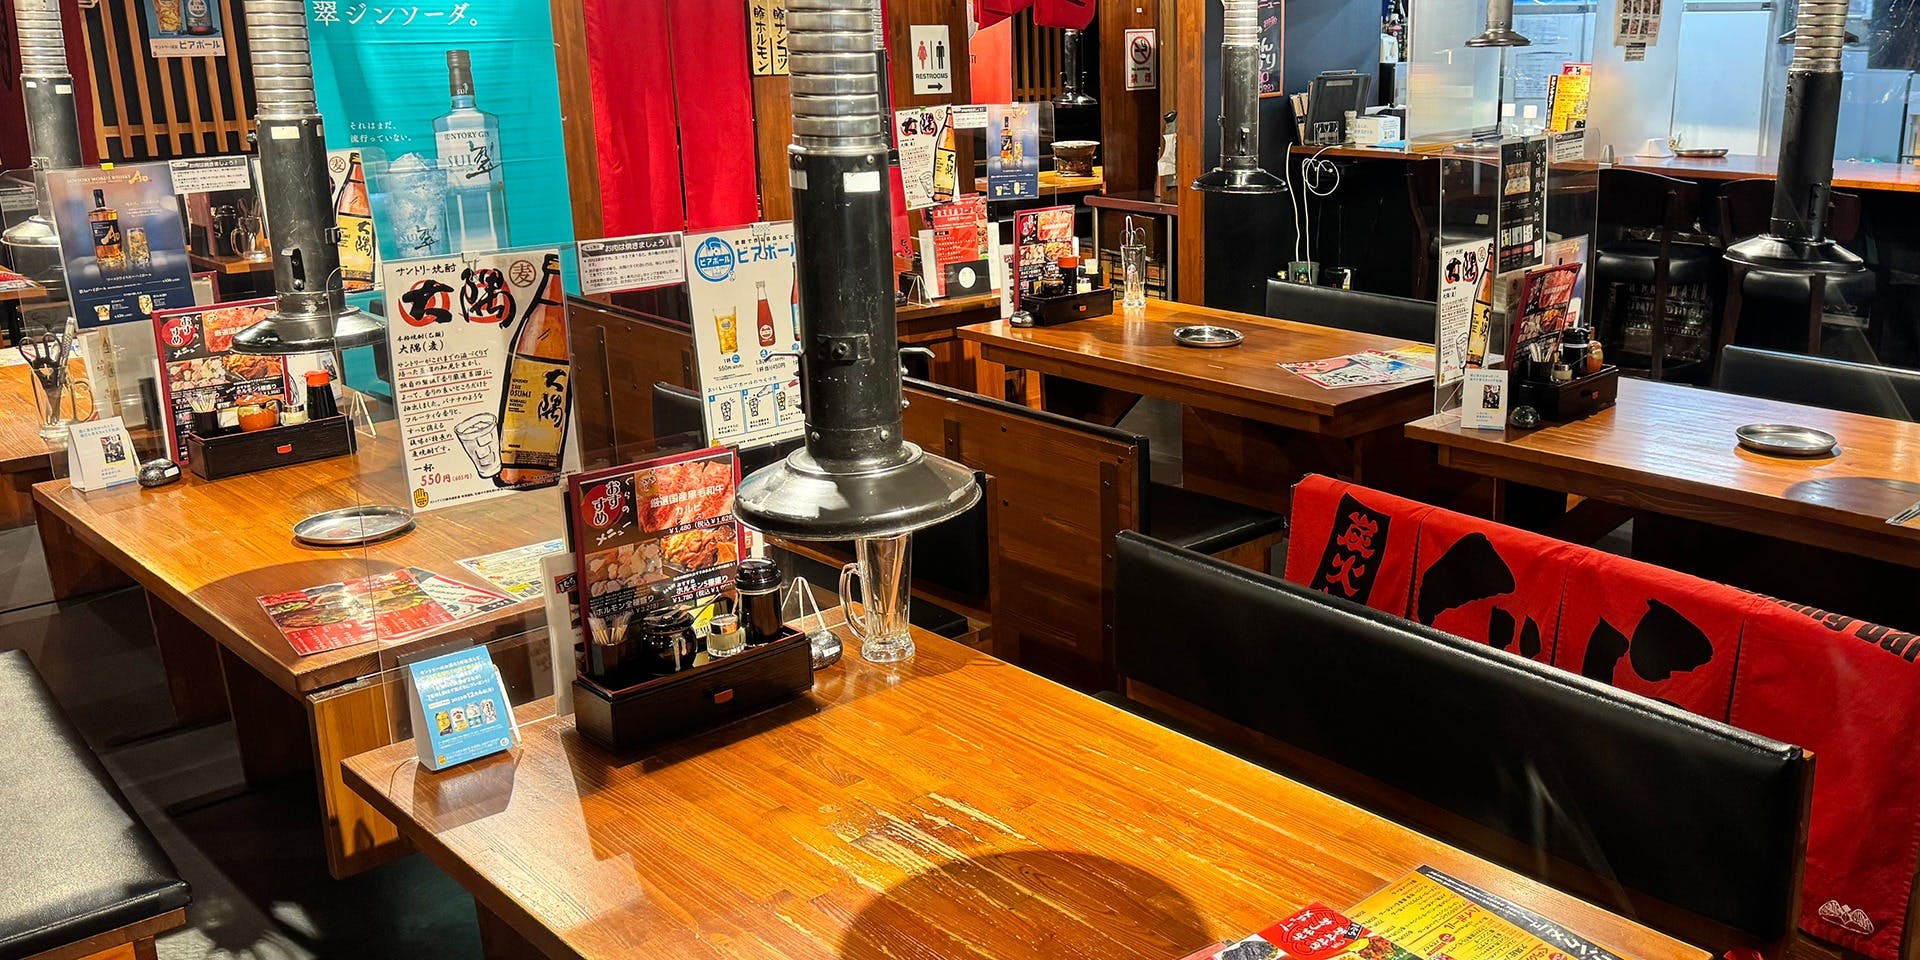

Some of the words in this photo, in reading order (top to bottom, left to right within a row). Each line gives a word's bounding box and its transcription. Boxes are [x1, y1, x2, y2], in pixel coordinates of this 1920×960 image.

[312, 1, 479, 27] 翠ジンソーダ。
[350, 122, 397, 130] それはまだ、
[448, 155, 471, 167] SUI
[512, 263, 532, 283] 麦
[402, 268, 516, 330] 大隅
[398, 340, 444, 354] 大隅(麦)
[510, 390, 531, 398] OSUMI
[592, 480, 622, 526] おすすめ
[596, 521, 632, 546] メニュー
[1311, 511, 1378, 597] 炭火
[1292, 918, 1332, 940] おつまみ
[1444, 907, 1480, 930] ハイボール
[1310, 927, 1347, 950] おすすめ
